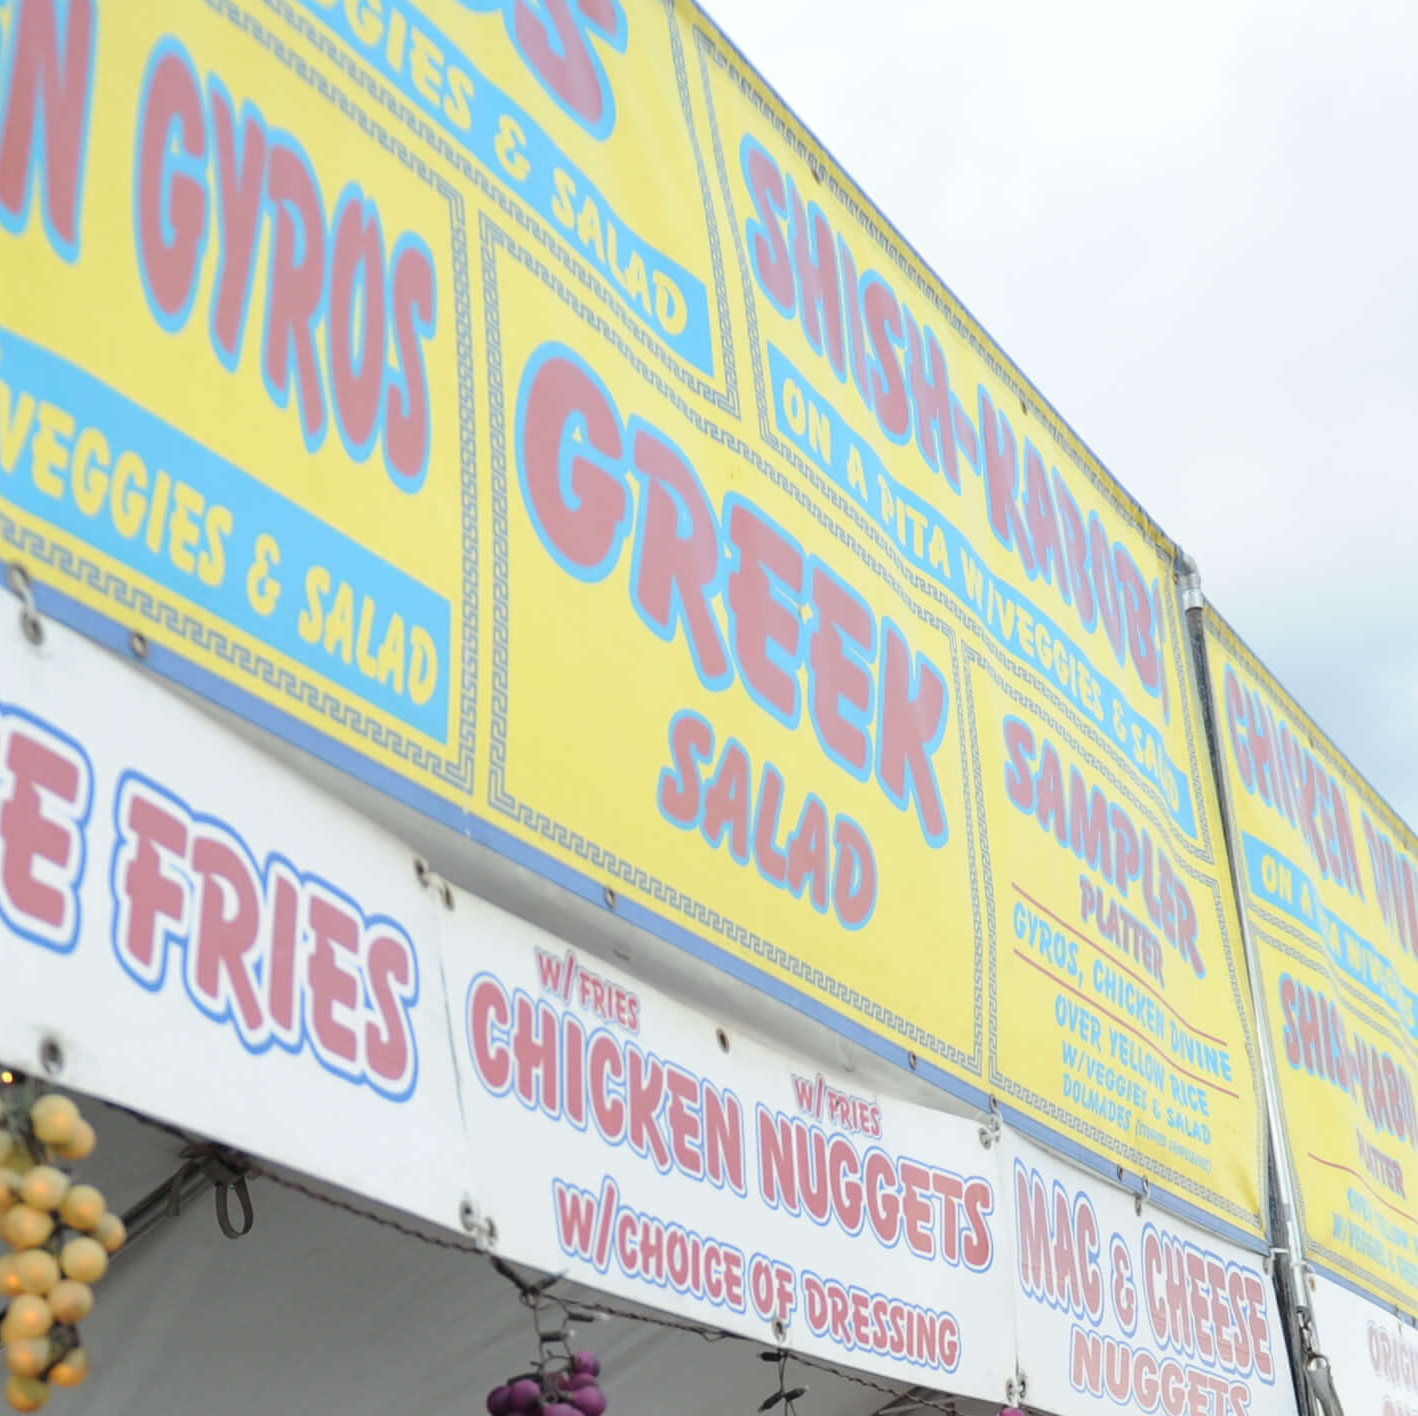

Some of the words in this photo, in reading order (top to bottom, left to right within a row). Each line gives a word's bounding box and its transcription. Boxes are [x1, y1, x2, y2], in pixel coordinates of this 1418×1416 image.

[134, 33, 438, 494] GYROS
[493, 113, 532, 183] &
[551, 167, 688, 337] SALAD
[246, 533, 284, 617] &
[298, 564, 441, 707] SALAD
[515, 340, 950, 850] GREEK
[782, 377, 831, 466] ON
[846, 443, 869, 502] A
[877, 473, 952, 581] PITA
[960, 546, 1105, 723] W/VEGGIES
[656, 708, 879, 931] SALAD
[1003, 713, 1207, 980] SAMPLER
[110, 766, 421, 1104] FRIES
[534, 945, 640, 1033] W/FRIES
[1013, 901, 1085, 989] GYROS,
[1092, 958, 1166, 1044] CHICKEN
[1079, 873, 1166, 990] PLATTER
[465, 970, 748, 1199] CHICKEN
[754, 1100, 994, 1274] NUGGETS
[791, 1071, 883, 1140] W/FRIES
[1054, 993, 1103, 1053] OVER
[1107, 1025, 1166, 1093] YELLOW
[1168, 1072, 1211, 1118] RICE
[1062, 1072, 1132, 1133] DOLMADES
[1166, 1106, 1213, 1147] SALAD
[552, 1176, 747, 1314] W/CHOICE
[749, 1253, 797, 1328] OF
[800, 1269, 962, 1374] DRESSING
[1013, 1155, 1104, 1327] MAC
[1109, 1232, 1138, 1339] &
[1140, 1221, 1276, 1388] CHEESE
